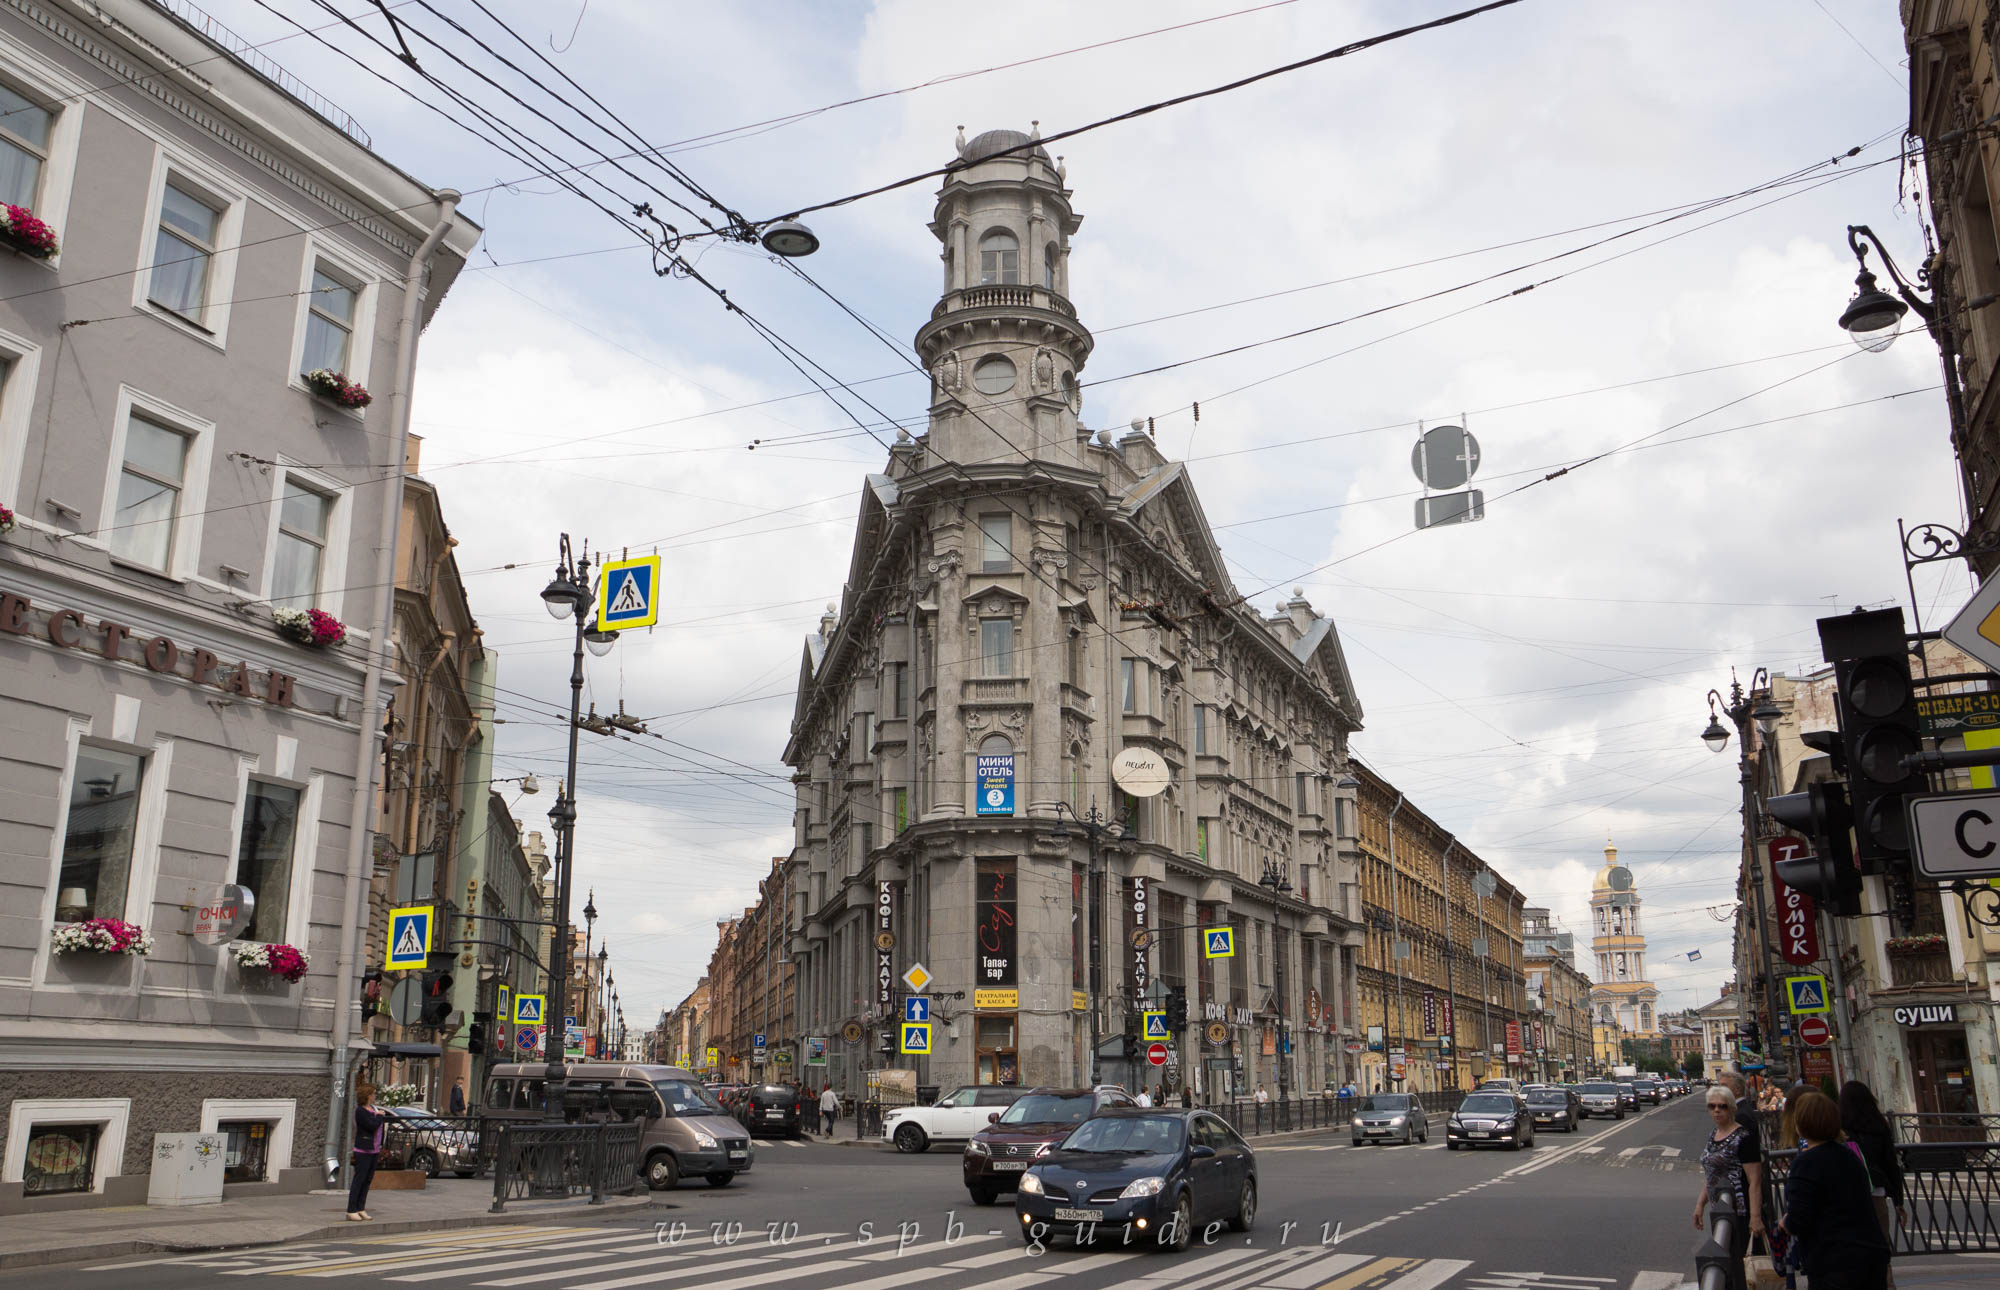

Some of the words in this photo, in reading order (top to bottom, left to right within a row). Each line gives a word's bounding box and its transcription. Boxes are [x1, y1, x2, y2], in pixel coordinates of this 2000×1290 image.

[979, 757, 1013, 767] МИНИ
[978, 767, 1013, 777] ОТЕЛЬ
[992, 791, 999, 801] 3
[879, 881, 892, 929] КОФЕ
[1133, 877, 1146, 925] КОФЕ
[1778, 844, 1809, 955] Темок
[200, 905, 237, 921] ОЧКИ
[982, 956, 1008, 968] Тапас
[879, 954, 891, 1002] ХАУЗ
[987, 968, 1003, 980] бар
[1135, 951, 1146, 998] ХАУЗ
[1206, 1002, 1226, 1021] КОФЕ
[1236, 1007, 1253, 1025] ХАУЗ
[756, 1035, 764, 1046] P
